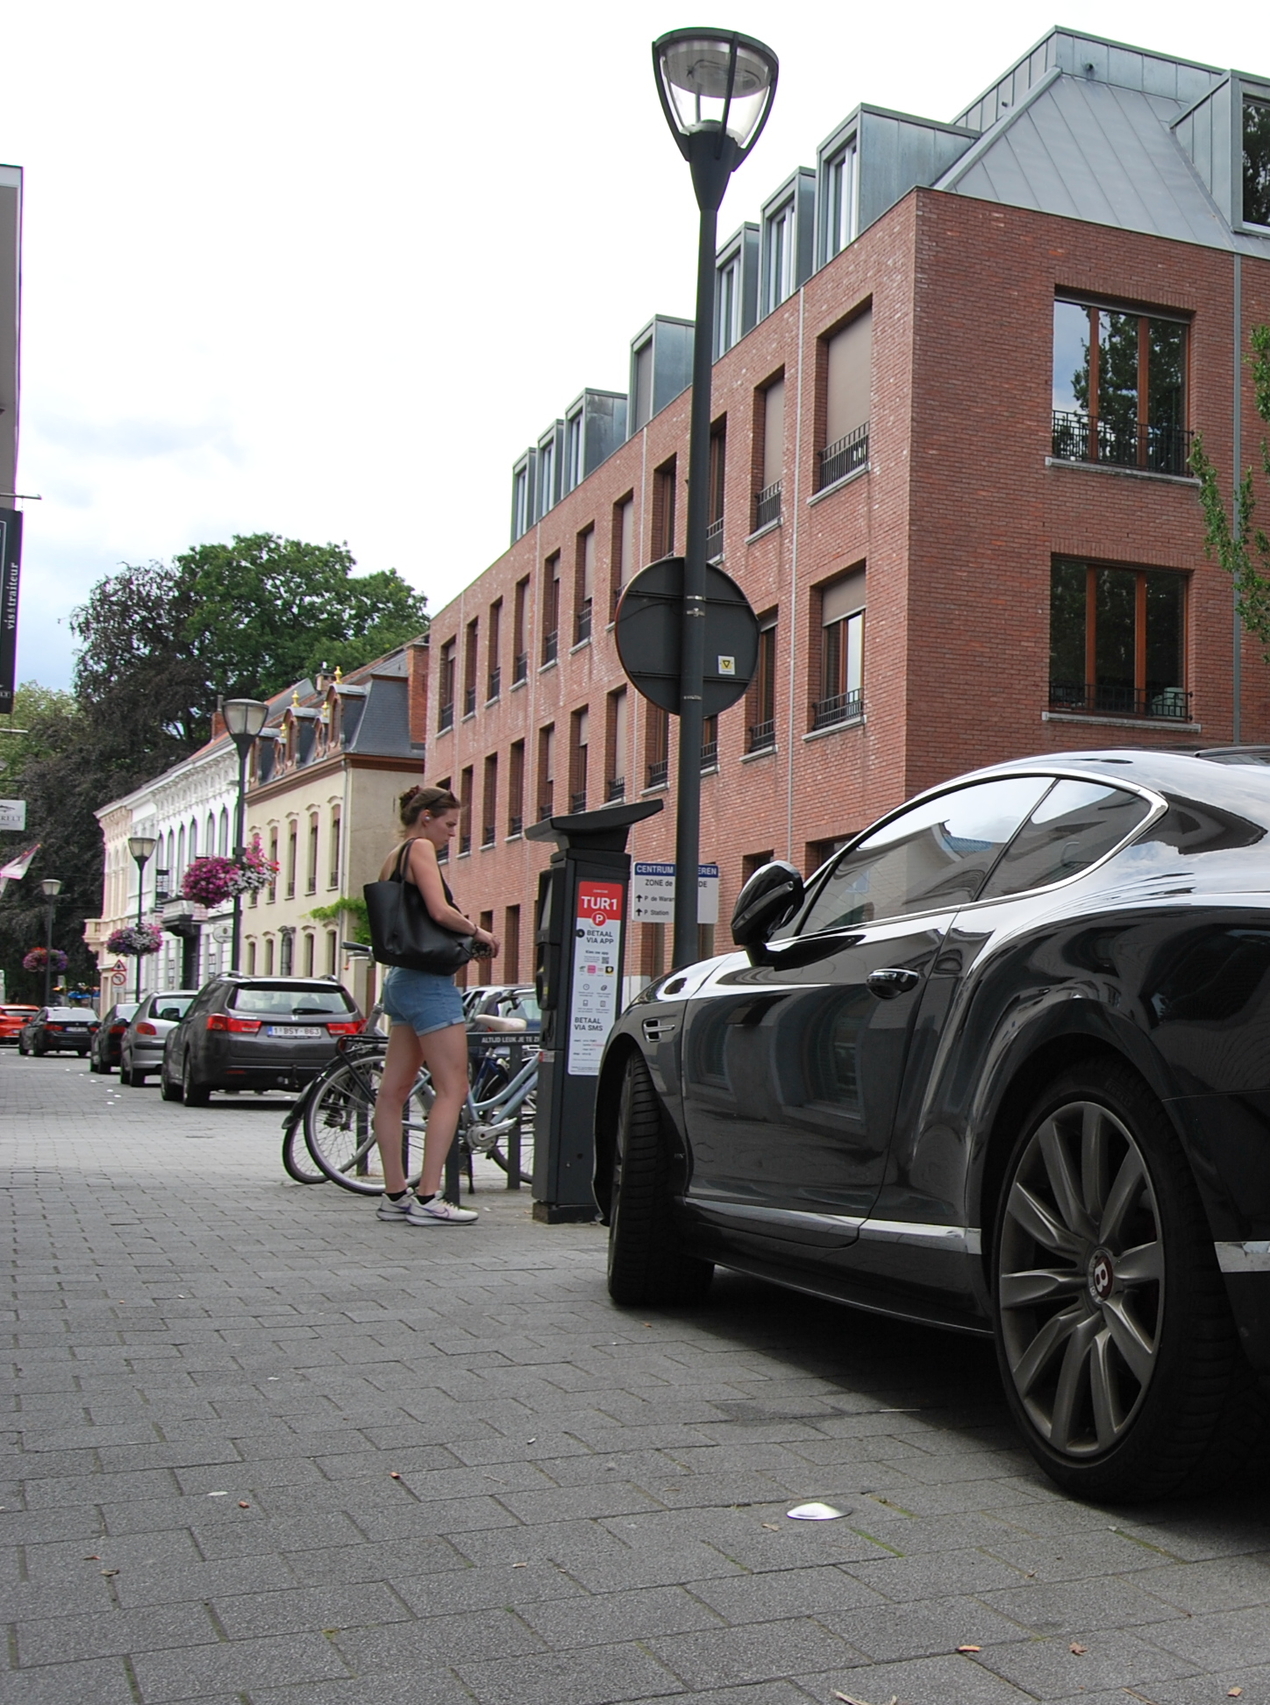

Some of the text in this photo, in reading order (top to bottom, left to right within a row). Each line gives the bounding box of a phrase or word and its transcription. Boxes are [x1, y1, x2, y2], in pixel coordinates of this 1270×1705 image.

[5, 562, 19, 607] traiteur
[636, 865, 674, 874] CENTRUM
[665, 879, 673, 887] de
[581, 896, 618, 911] TUR1
[595, 914, 604, 924] P
[586, 929, 613, 938] BETAAL
[574, 1016, 602, 1024] BETAAL
